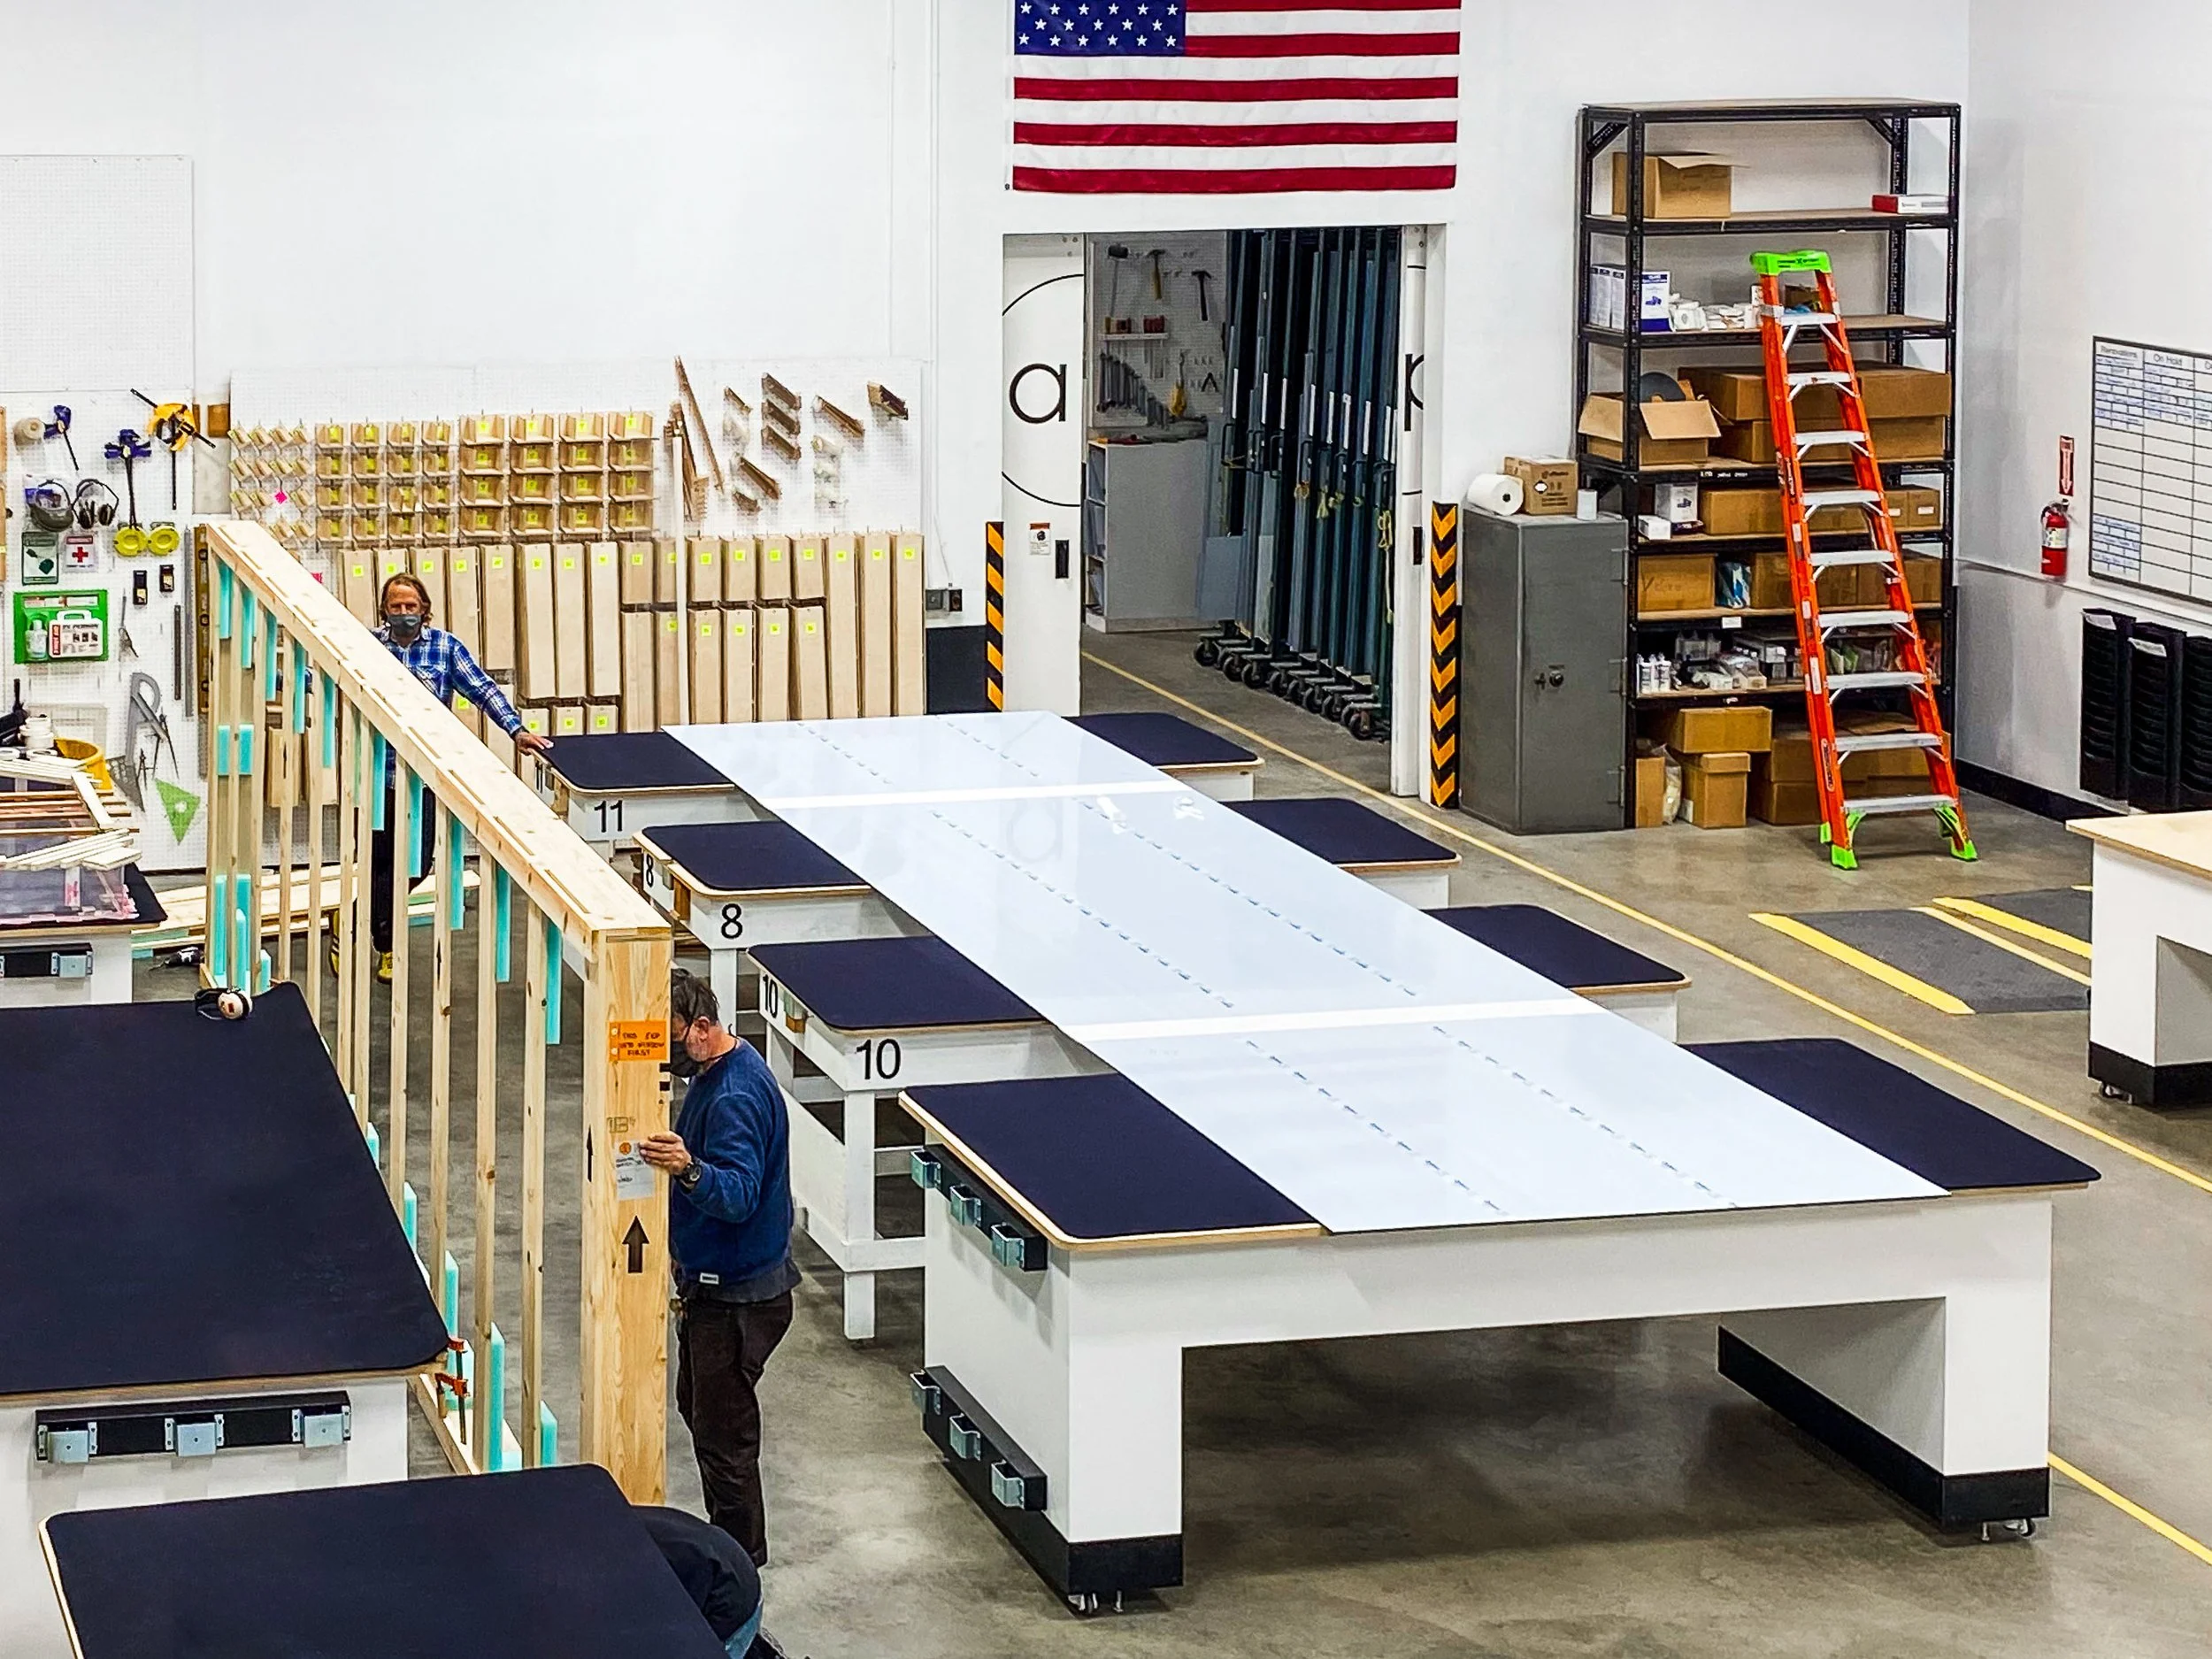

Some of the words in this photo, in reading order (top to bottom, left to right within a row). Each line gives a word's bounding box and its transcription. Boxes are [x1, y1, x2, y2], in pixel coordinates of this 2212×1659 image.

[1009, 363, 1067, 425] a
[594, 799, 623, 833] 11
[646, 853, 654, 887] 8
[720, 902, 743, 940] 8
[763, 973, 779, 1018] 10
[856, 1038, 902, 1079] 10
